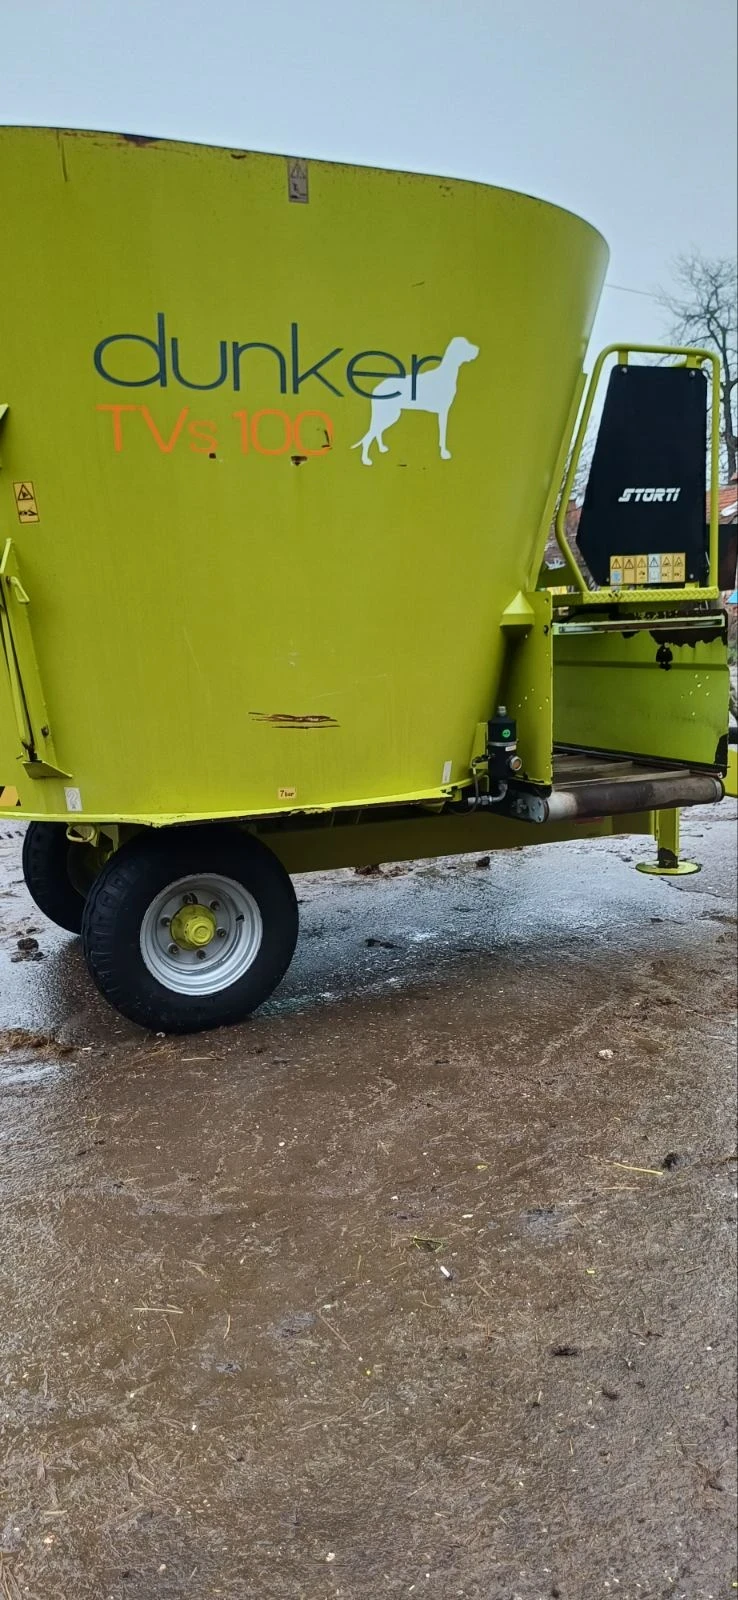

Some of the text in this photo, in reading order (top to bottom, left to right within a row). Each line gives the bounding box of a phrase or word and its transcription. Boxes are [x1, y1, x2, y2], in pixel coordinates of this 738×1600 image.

[93, 312, 443, 401] dunker
[95, 404, 334, 457] TVs 100
[617, 487, 681, 502] STORTI
